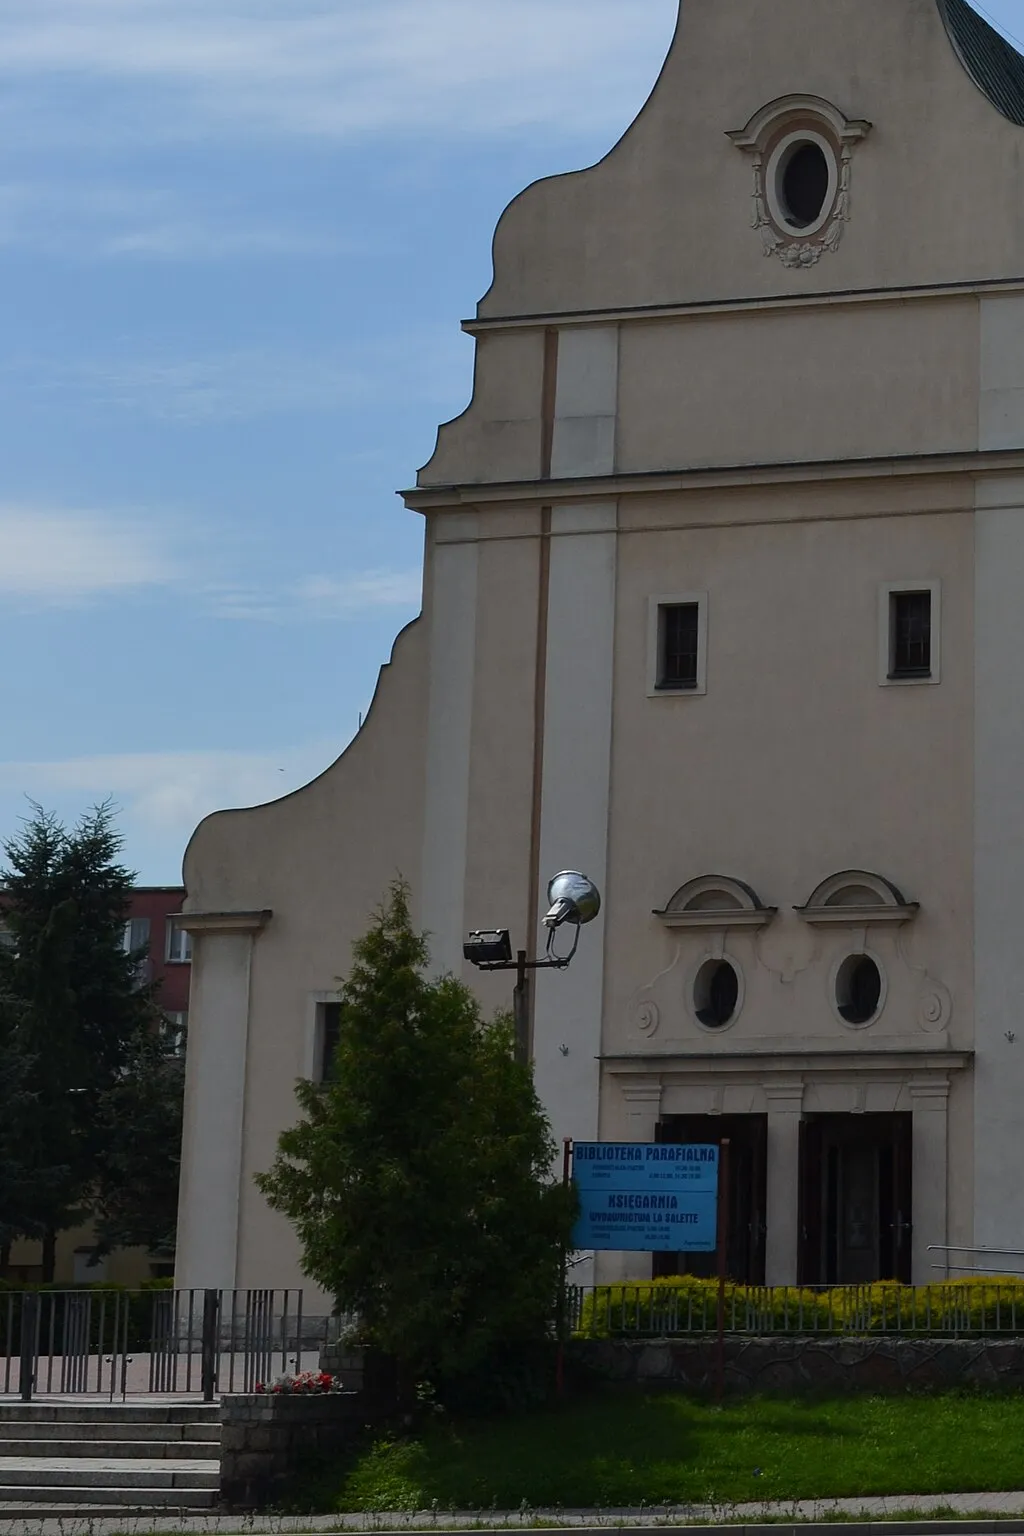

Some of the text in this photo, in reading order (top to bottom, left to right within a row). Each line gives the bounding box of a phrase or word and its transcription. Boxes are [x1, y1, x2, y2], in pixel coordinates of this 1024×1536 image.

[576, 1146, 715, 1162] BIBLIOTEKA PARAFIALNA
[608, 1194, 678, 1210] KSIĘGARNIA
[589, 1211, 699, 1224] WYDAWNICTWA LA SALETTE
